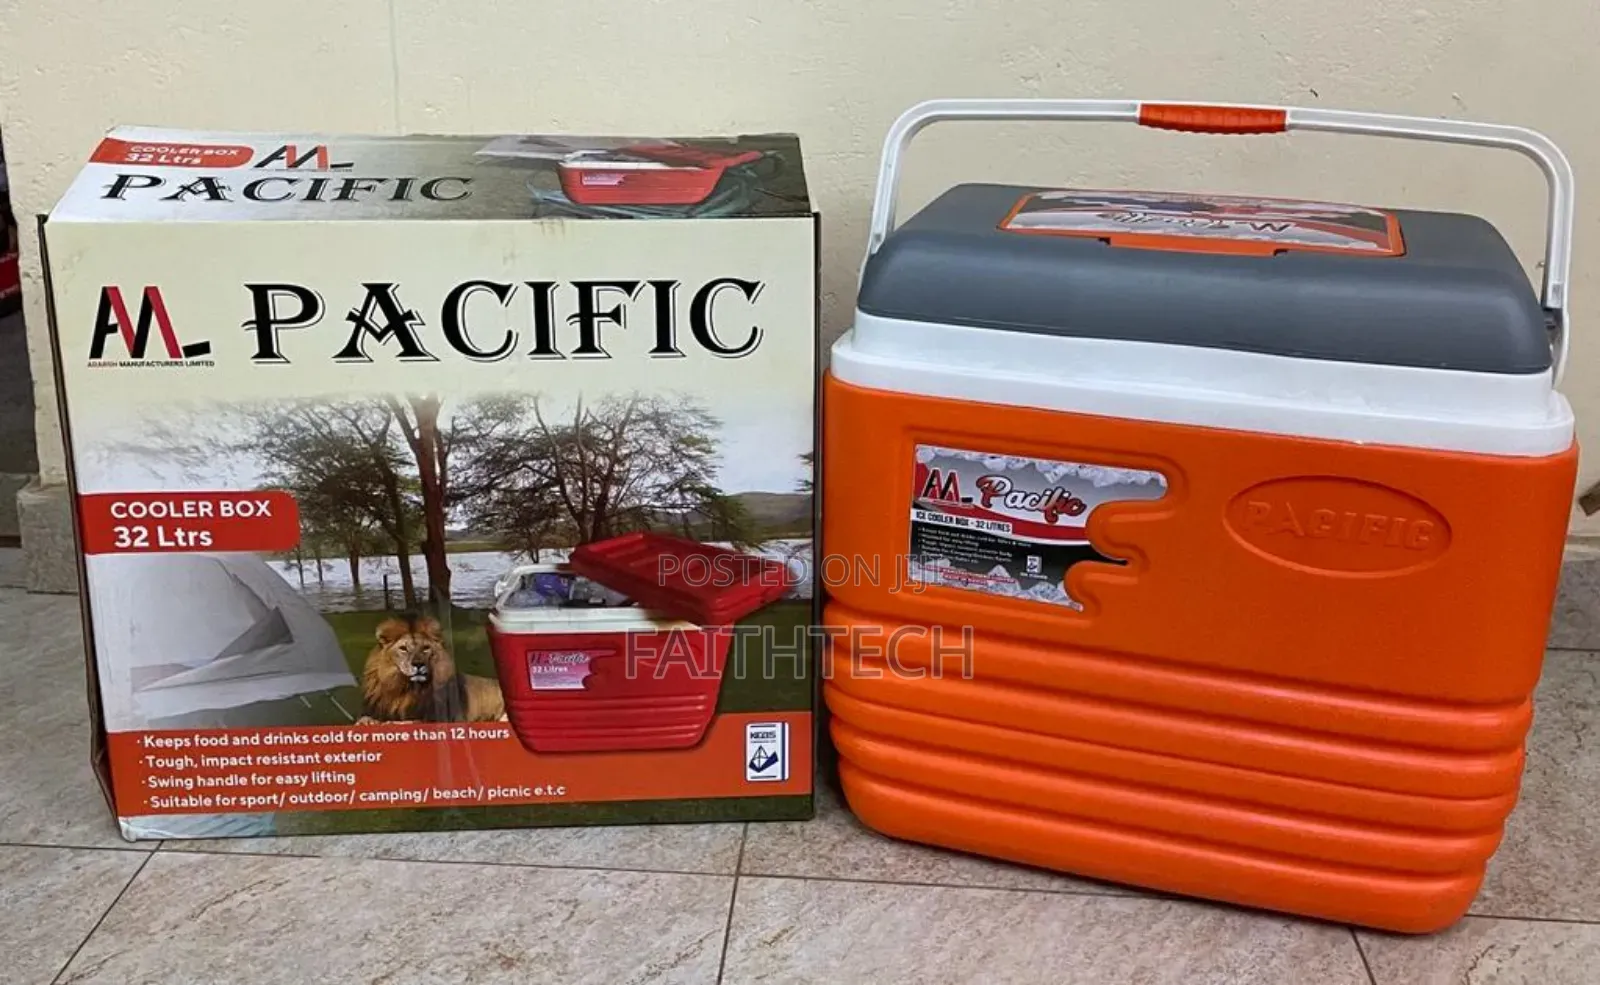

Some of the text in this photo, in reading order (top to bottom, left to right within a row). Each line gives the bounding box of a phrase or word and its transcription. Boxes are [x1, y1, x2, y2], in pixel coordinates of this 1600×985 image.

[124, 153, 203, 165] 32 Ltrs
[131, 145, 239, 157] COOLER BOX
[102, 174, 476, 203] PACIFIC
[241, 278, 766, 363] PACIFIC
[110, 500, 272, 519] COOLER BOX
[976, 474, 1088, 525] Pacific
[113, 525, 213, 548] 32 Ltrs
[1241, 500, 1435, 551] PACIFIC
[144, 727, 511, 750] Keeps food and drinks cold for more than 12 hours
[145, 749, 382, 770] Tough, impact resistant exterior
[148, 770, 356, 790] Swing handle for easy lifting
[150, 784, 567, 809] Suitable for sport/ outdoor/ camping/ beach/ picnic e.t.c
